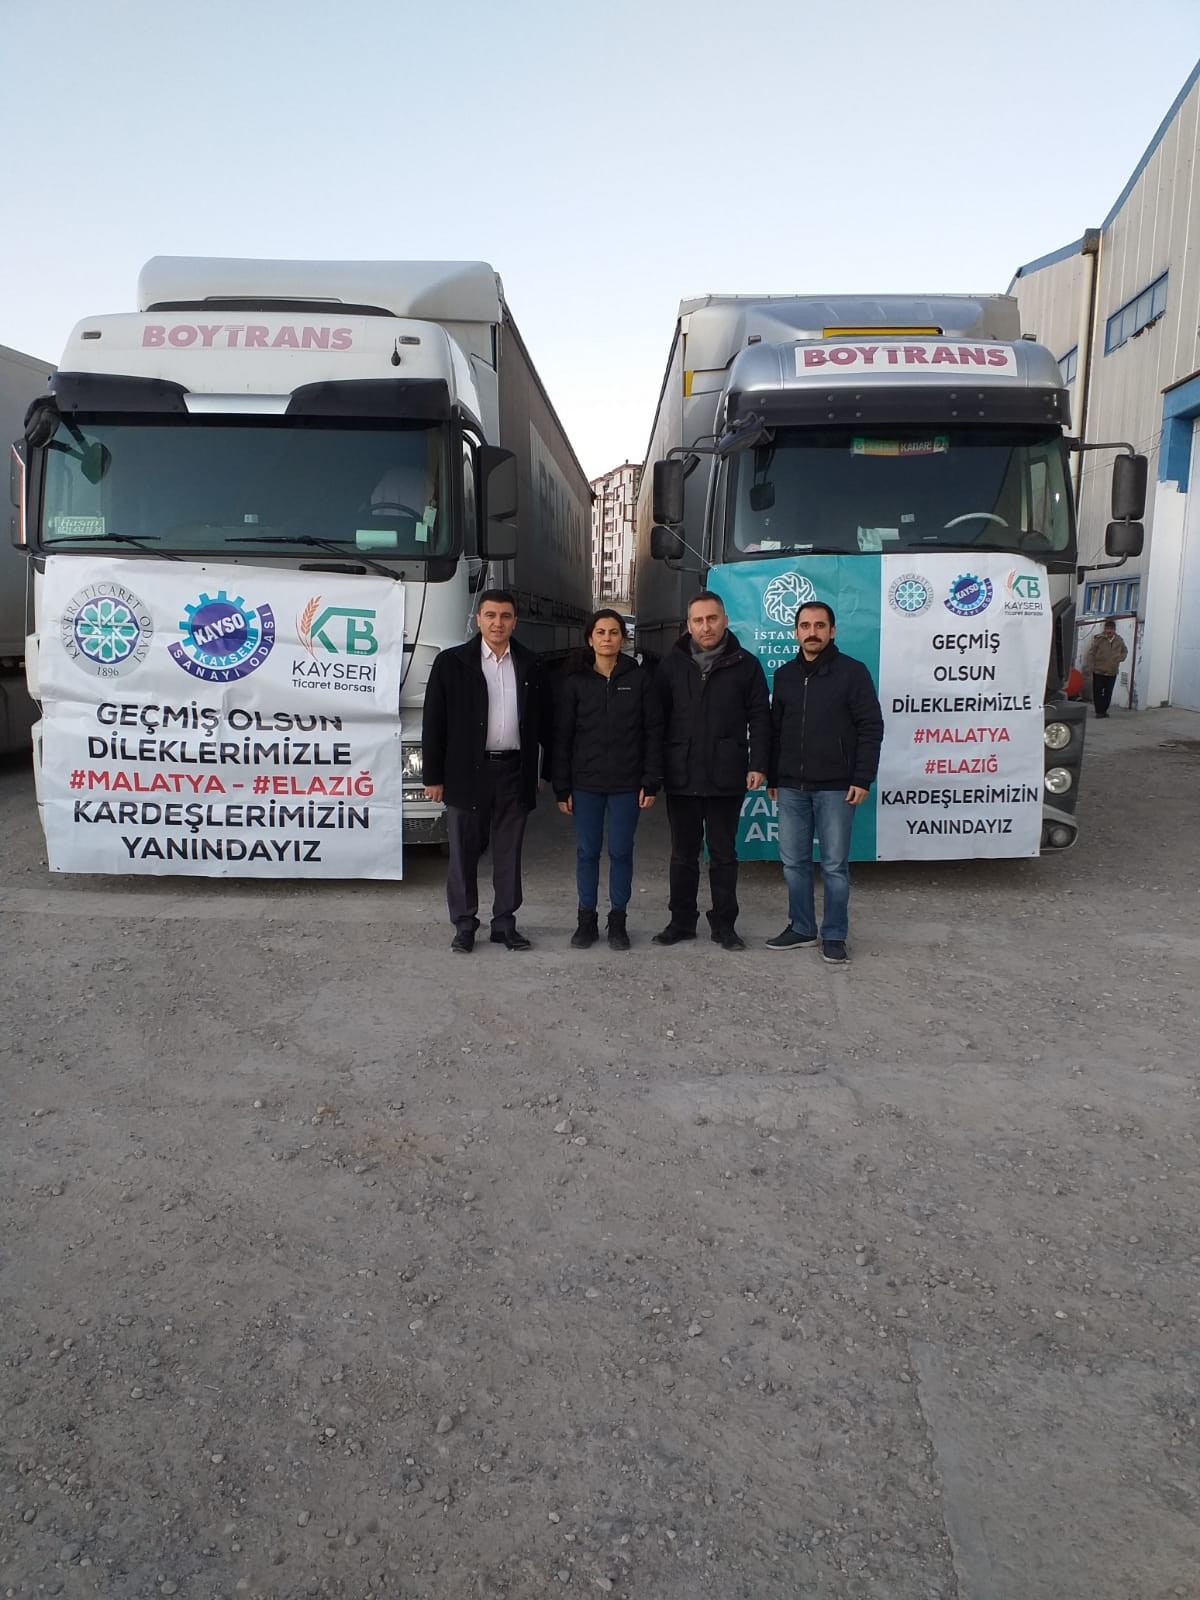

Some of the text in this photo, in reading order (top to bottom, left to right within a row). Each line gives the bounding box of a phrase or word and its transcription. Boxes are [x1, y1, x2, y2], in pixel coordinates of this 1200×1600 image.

[142, 324, 353, 350] BOYTRANS
[804, 346, 1008, 367] BOYTRANS
[955, 583, 980, 600] KAYSO
[133, 616, 153, 663] ODASI
[193, 613, 245, 646] KAYSO
[249, 611, 275, 668] ODASI
[754, 628, 796, 640] İSTAN
[758, 643, 800, 654] TİCAR
[932, 629, 1000, 654] GEÇMİŞ
[97, 666, 120, 677] 1896
[292, 659, 377, 682] KAYSERİ
[934, 665, 995, 682] OLSUN
[291, 678, 376, 693] Ticaret Borsası
[892, 693, 1031, 713] DİLEKLERİMİZLE
[97, 700, 343, 737] GEÇMİŞ OLSUN
[913, 727, 1010, 744] #MALATYA
[88, 732, 352, 766] DİLEKLERİMİZLE
[925, 755, 997, 774] #ELAZIĞ
[69, 769, 226, 795] #MALATYA
[253, 769, 374, 797] #ELAZIĞ
[881, 783, 1038, 809] KARDEŞLERİMİZİN
[74, 799, 370, 833] KARDEŞLERİMİZİN
[906, 819, 1013, 835] YANINDAYIZ
[121, 836, 322, 862] YANINDAYIZ
